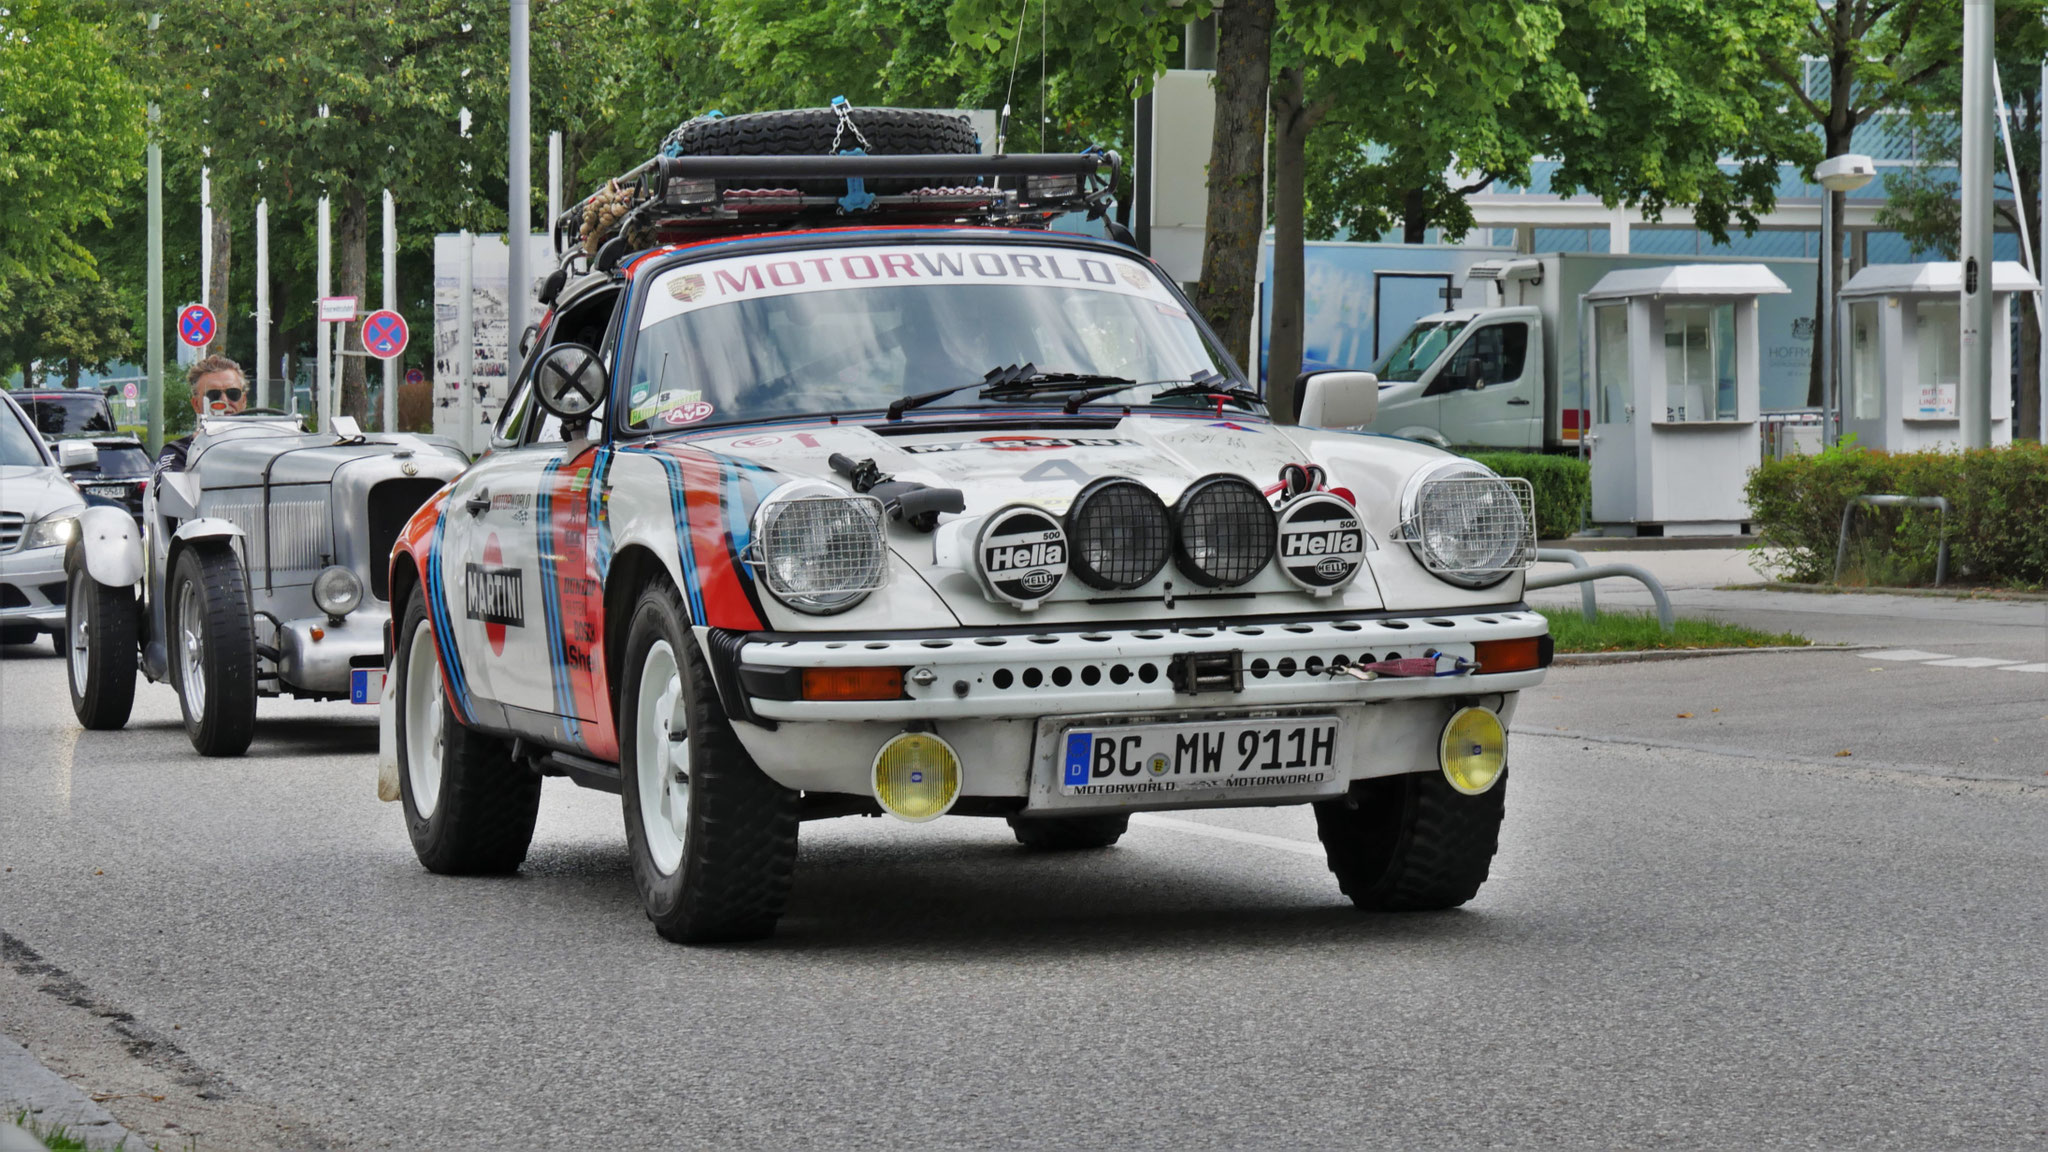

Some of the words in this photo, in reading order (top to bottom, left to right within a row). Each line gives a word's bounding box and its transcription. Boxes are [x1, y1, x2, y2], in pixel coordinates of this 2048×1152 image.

[712, 251, 1116, 295] MOTORWORLD
[1768, 346, 1812, 358] HOFFM
[912, 438, 1142, 453] MARTINI
[1339, 520, 1357, 529] 500
[1043, 531, 1061, 540] 500
[1286, 532, 1358, 556] Hella
[991, 543, 1062, 570] Hella
[1318, 562, 1348, 573] HELLA
[1024, 573, 1054, 585] HELLA
[467, 571, 523, 620] MARTINI
[356, 690, 363, 698] D
[1071, 764, 1082, 776] D
[1092, 735, 1142, 778] BC
[1174, 731, 1225, 775] MW
[1237, 726, 1336, 771] 911H
[1073, 781, 1175, 795] MOTORWORLD
[1225, 772, 1324, 787] MOTORWORLD
